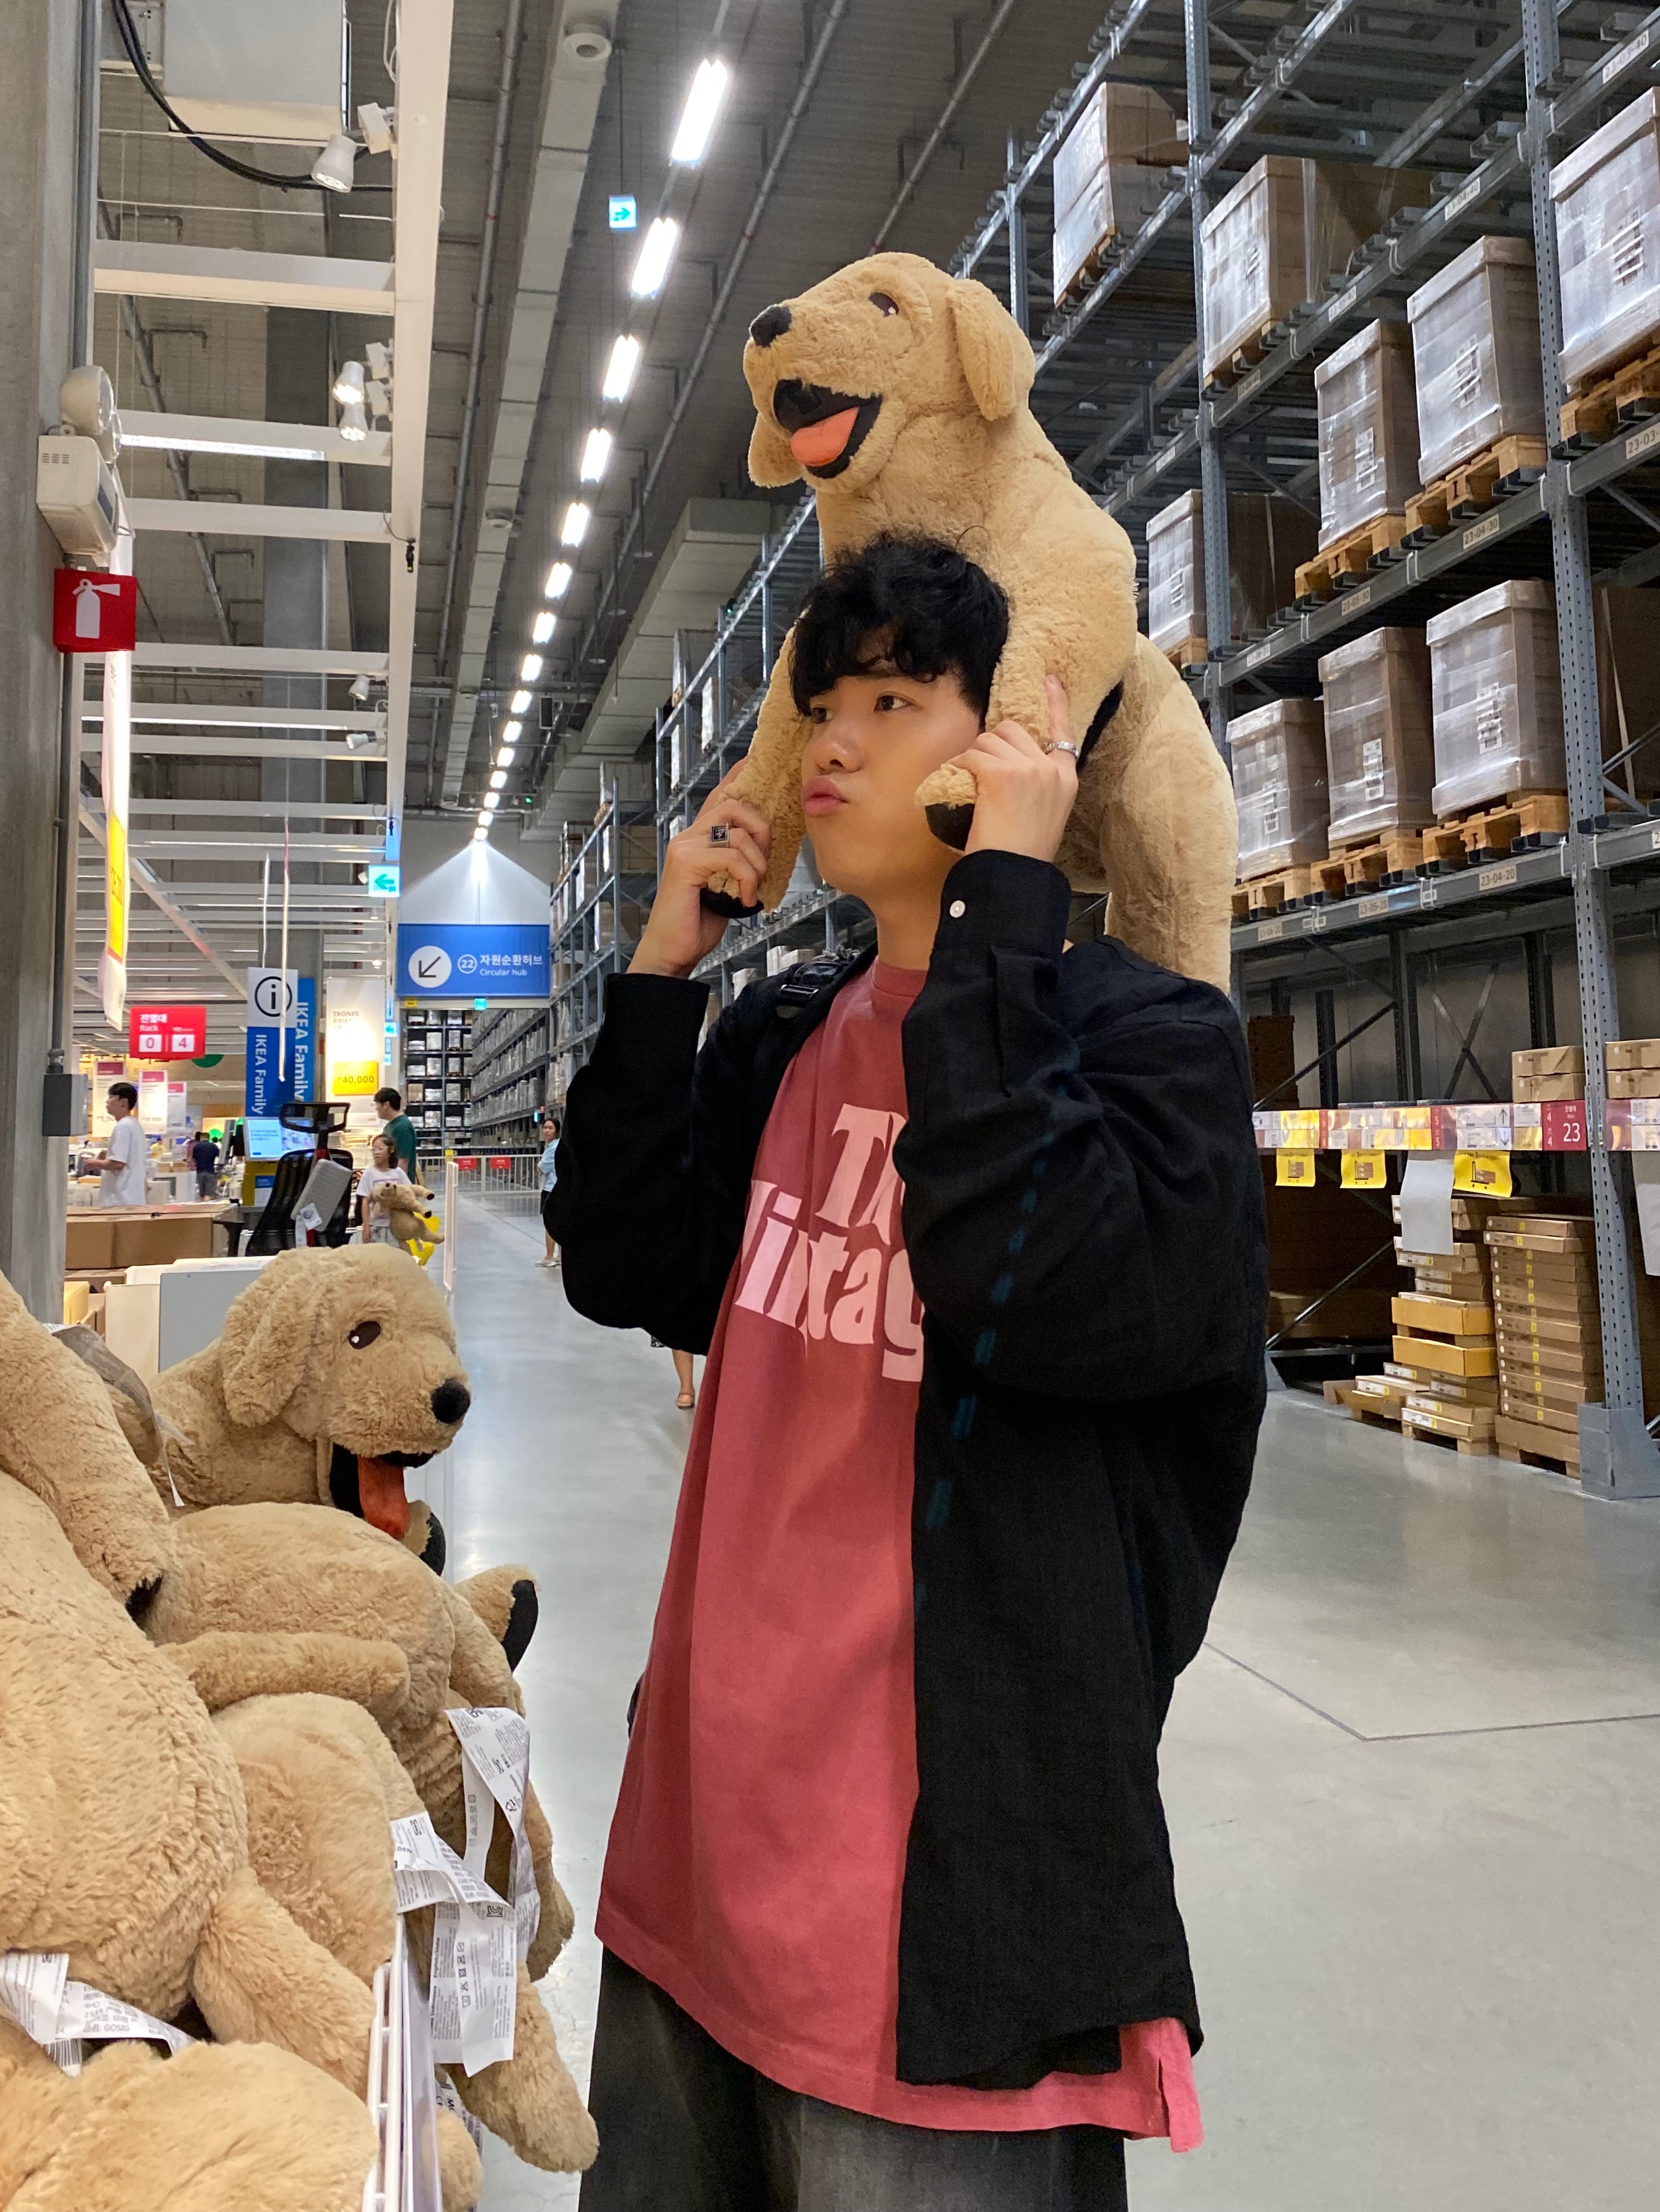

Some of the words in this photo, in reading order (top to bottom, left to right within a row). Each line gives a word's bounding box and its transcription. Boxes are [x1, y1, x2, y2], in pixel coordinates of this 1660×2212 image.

[1464, 518, 1498, 545] 23-04-30
[1481, 868, 1515, 887] 23-04-20
[460, 959, 474, 969] 22
[480, 954, 543, 966] 자원순환허브
[296, 1001, 309, 1039] IKEA
[178, 1036, 188, 1049] 4
[255, 1034, 267, 1066] IKEA
[251, 1069, 267, 1115] Family
[1563, 1122, 1581, 1142] 23
